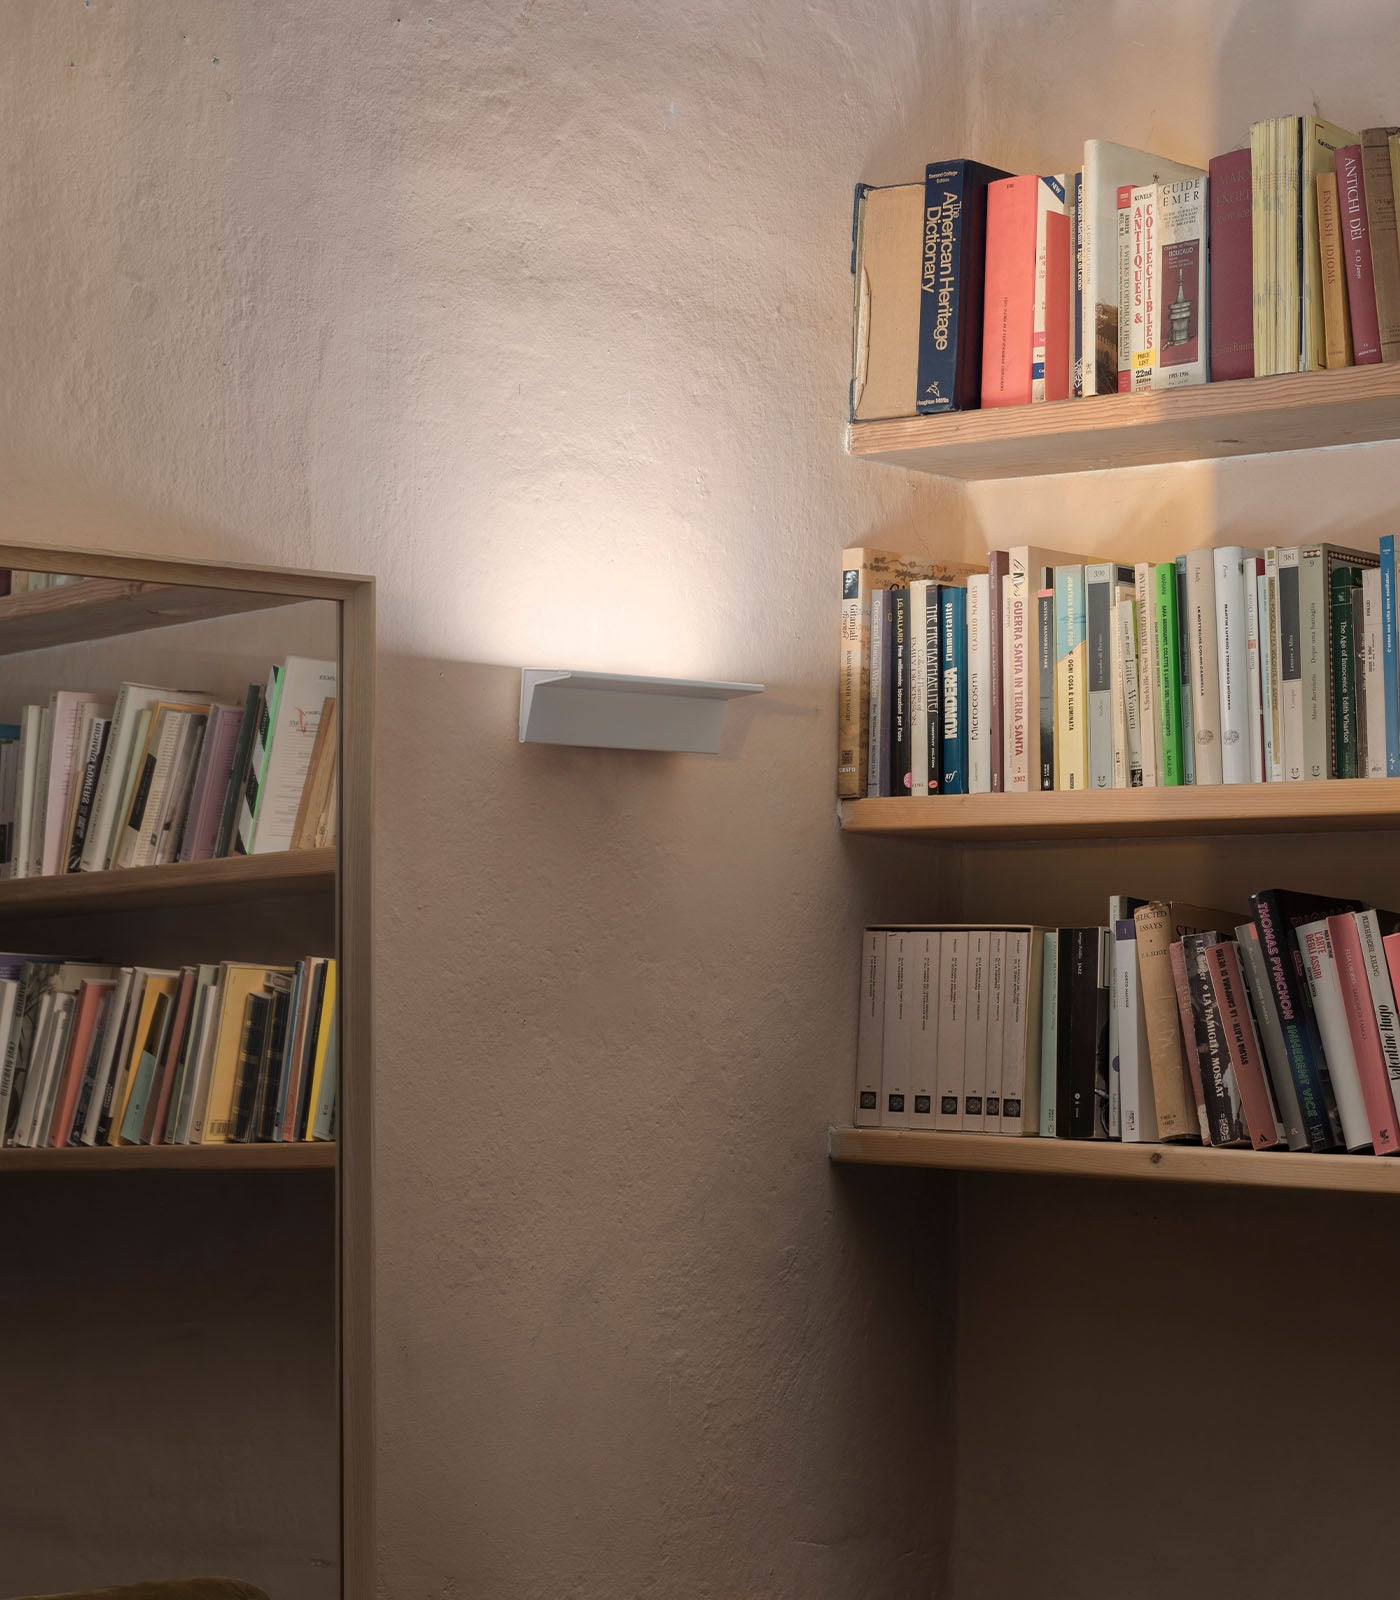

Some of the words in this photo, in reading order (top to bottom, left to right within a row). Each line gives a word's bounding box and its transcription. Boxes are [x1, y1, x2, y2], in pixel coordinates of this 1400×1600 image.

[1050, 180, 1062, 194] NEW
[1163, 179, 1200, 195] GUIDE
[1163, 191, 1199, 207] EMER
[1344, 157, 1361, 215] ANTICHI
[953, 201, 961, 218] The
[1323, 190, 1333, 236] ENGLISH
[940, 192, 957, 276] American
[922, 207, 941, 294] Dictionary
[1134, 206, 1143, 307] ANTIQUES
[1327, 244, 1337, 287] IDIOMS
[1145, 203, 1154, 350] COLLECTIBLES
[935, 276, 955, 351] Heritage
[1134, 312, 1143, 324] &
[1136, 368, 1152, 378] 22nd
[848, 604, 859, 641] Gitanjali
[926, 604, 938, 623] THE
[1013, 600, 1024, 641] GUERRA
[944, 602, 953, 662] l'immortalité
[1014, 644, 1024, 675] SANTA
[1124, 659, 1135, 685] Little
[871, 669, 880, 696] Writers
[1014, 677, 1024, 687] IN
[944, 667, 958, 739] KUNDERA
[971, 673, 979, 741] Microcosmi
[1014, 690, 1024, 722] TERRA
[1128, 690, 1138, 729] Women
[1014, 724, 1024, 756] SANTA
[1140, 922, 1164, 932] ESSAYS
[1314, 931, 1327, 954] L'ARTE
[1361, 914, 1374, 952] BERNHEIM
[1306, 934, 1317, 954] DEGLI
[1310, 956, 1322, 980] ASSIRI
[1370, 954, 1380, 977] CATHY
[1203, 994, 1212, 1006] LA
[1224, 978, 1234, 1008] CAMPANA
[1258, 902, 1278, 954] THOMAS
[1270, 956, 1294, 1020] PYNCHON
[1286, 1024, 1308, 1084] INHERENT
[1302, 1088, 1318, 1117] VICE
[1377, 1004, 1394, 1032] Hugo
[1205, 1008, 1218, 1056] FAMIGLIA
[1234, 1023, 1244, 1042] PLATH
[1238, 1044, 1248, 1065] SYLVIA
[1382, 1033, 1400, 1082] Valentine
[1211, 1058, 1224, 1098] MOSKAT
